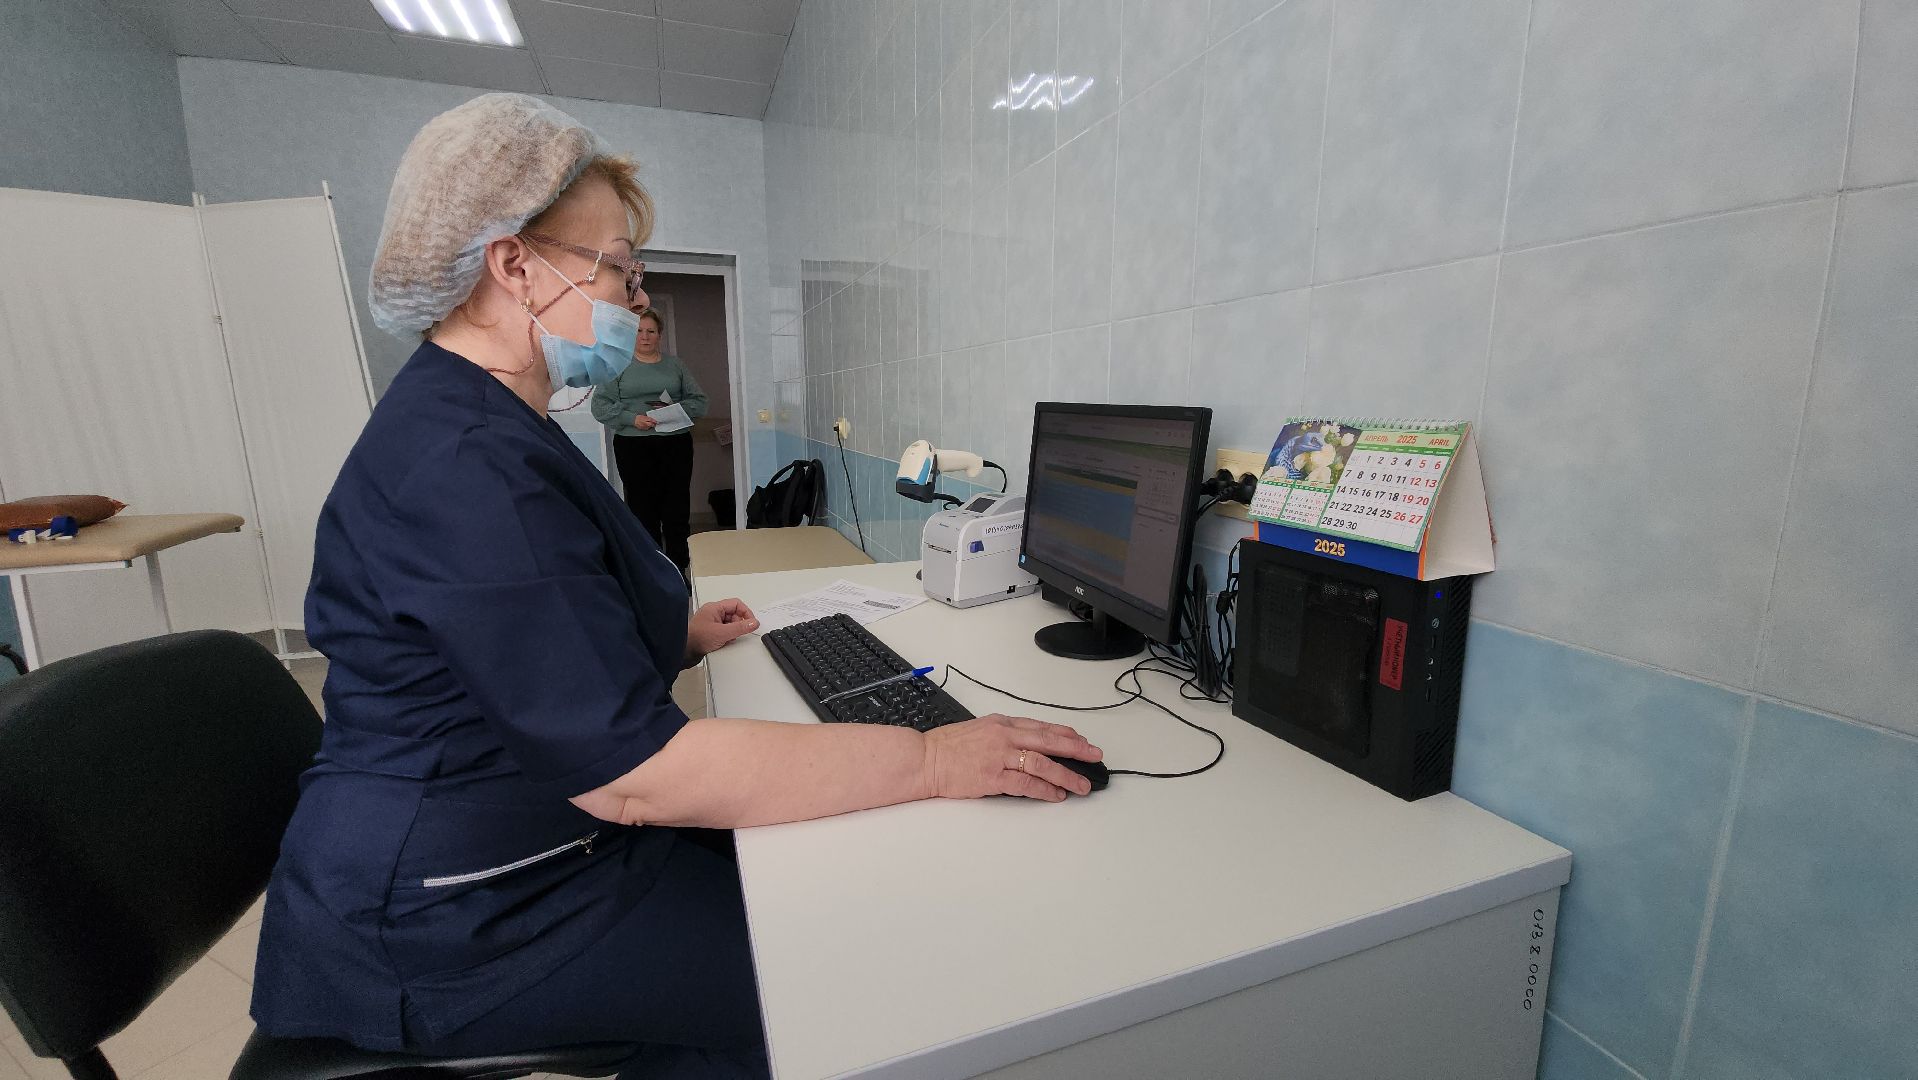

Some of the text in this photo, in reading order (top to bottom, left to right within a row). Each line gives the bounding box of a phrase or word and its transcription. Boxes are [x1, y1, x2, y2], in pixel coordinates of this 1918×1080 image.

[1396, 434, 1418, 445] 2025
[1428, 438, 1450, 447] APRIL
[1366, 455, 1441, 470] 1 2 3 4 5 6
[1344, 470, 1438, 488] 7 8 9 10 11 12 13
[1336, 486, 1347, 494] 14
[1348, 487, 1360, 496] 15
[1361, 488, 1372, 498] 16
[1374, 490, 1386, 499] 17
[1388, 492, 1400, 502] 18
[1402, 494, 1414, 504] 19
[1415, 496, 1430, 506] 20
[1328, 501, 1424, 524] 21 22 23 24 25 26 27
[1320, 516, 1358, 530] 28 29 30
[1314, 538, 1346, 557] 2025
[1075, 585, 1085, 596] AOC
